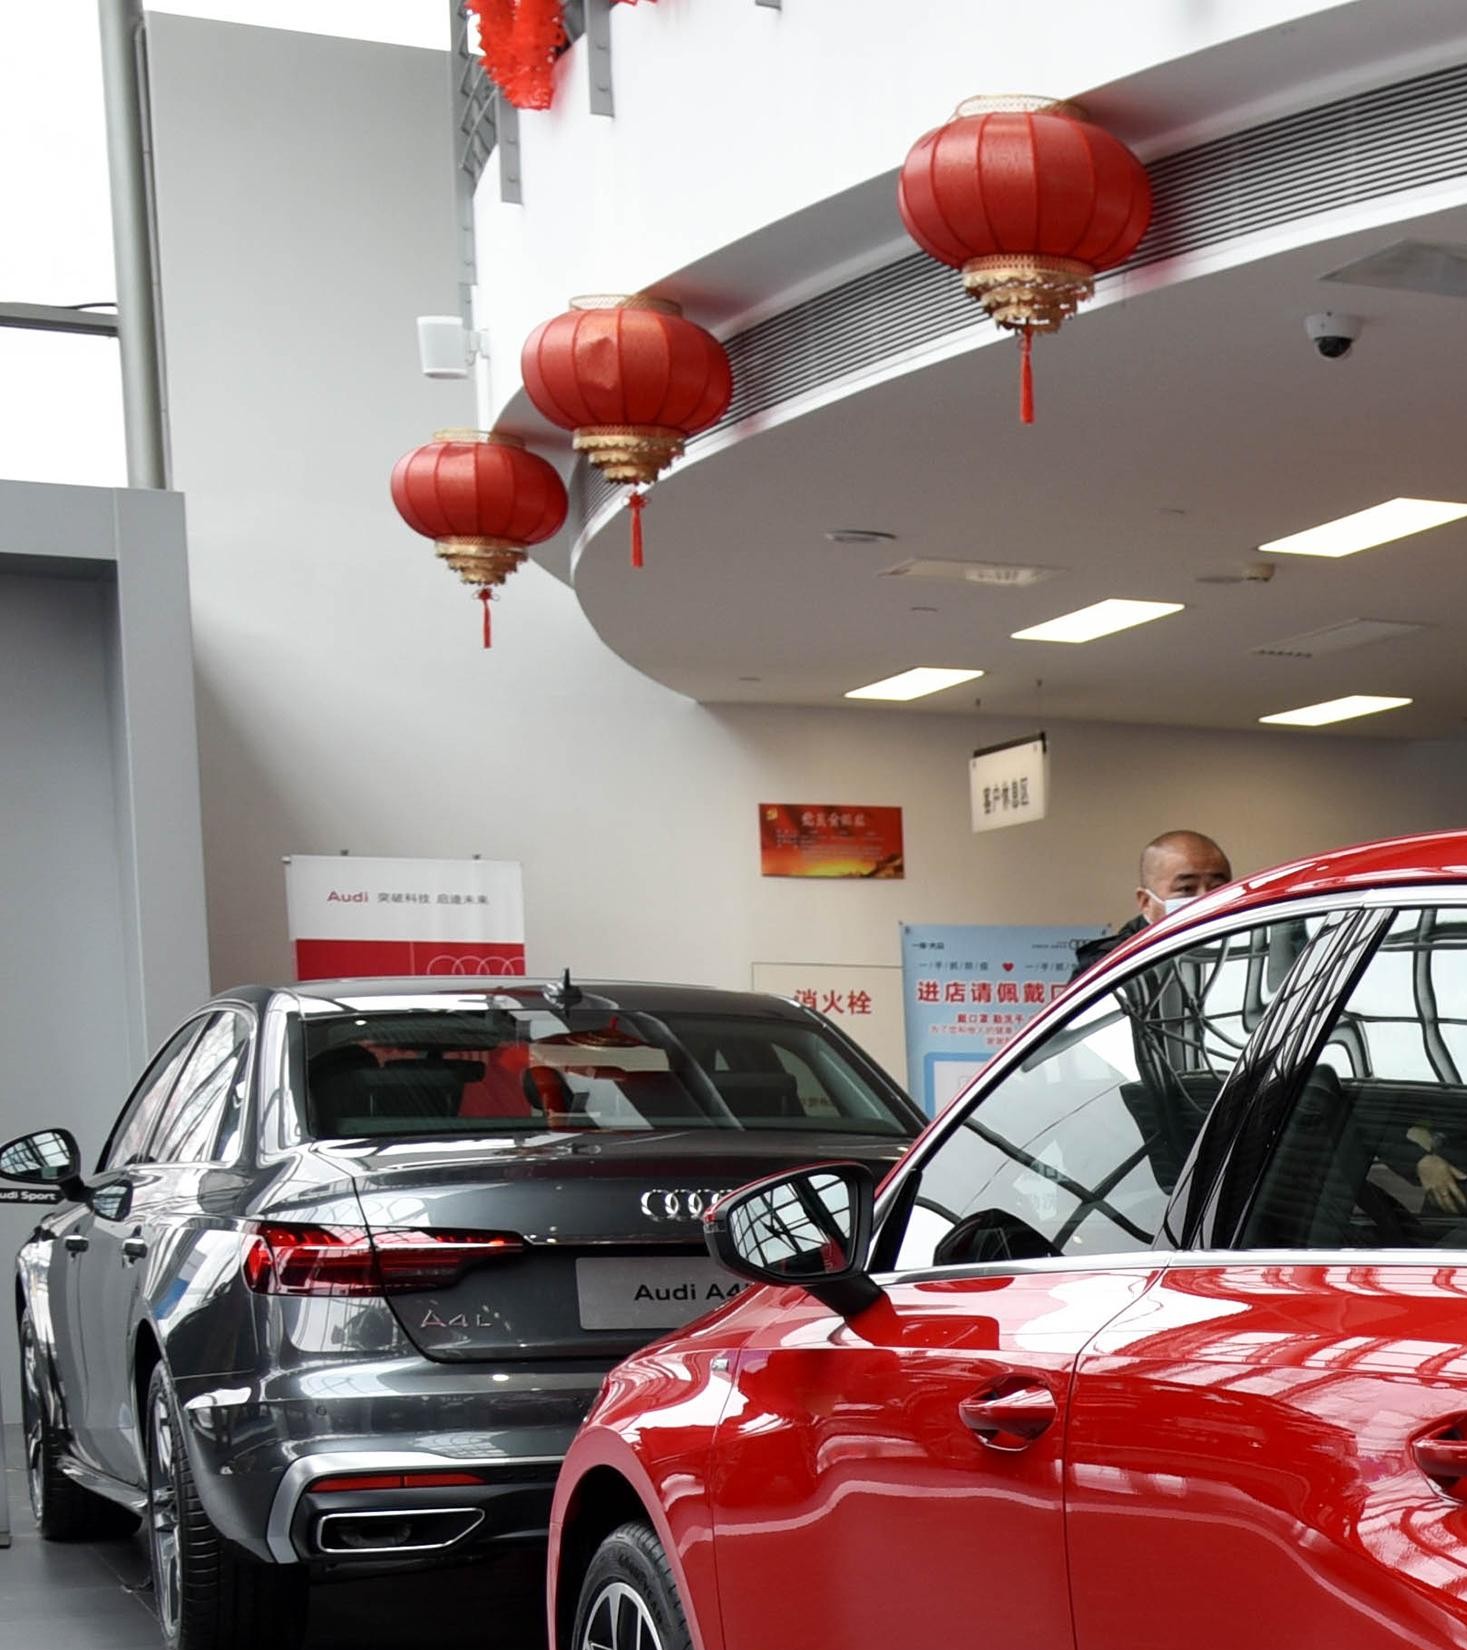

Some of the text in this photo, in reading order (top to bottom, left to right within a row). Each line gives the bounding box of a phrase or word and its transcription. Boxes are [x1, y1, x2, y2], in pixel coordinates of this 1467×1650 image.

[327, 890, 368, 903] Audi
[794, 989, 873, 1015] 消火栓
[21, 1191, 56, 1202] Sport
[634, 1284, 696, 1302] Audi
[419, 1309, 498, 1329] A4L
